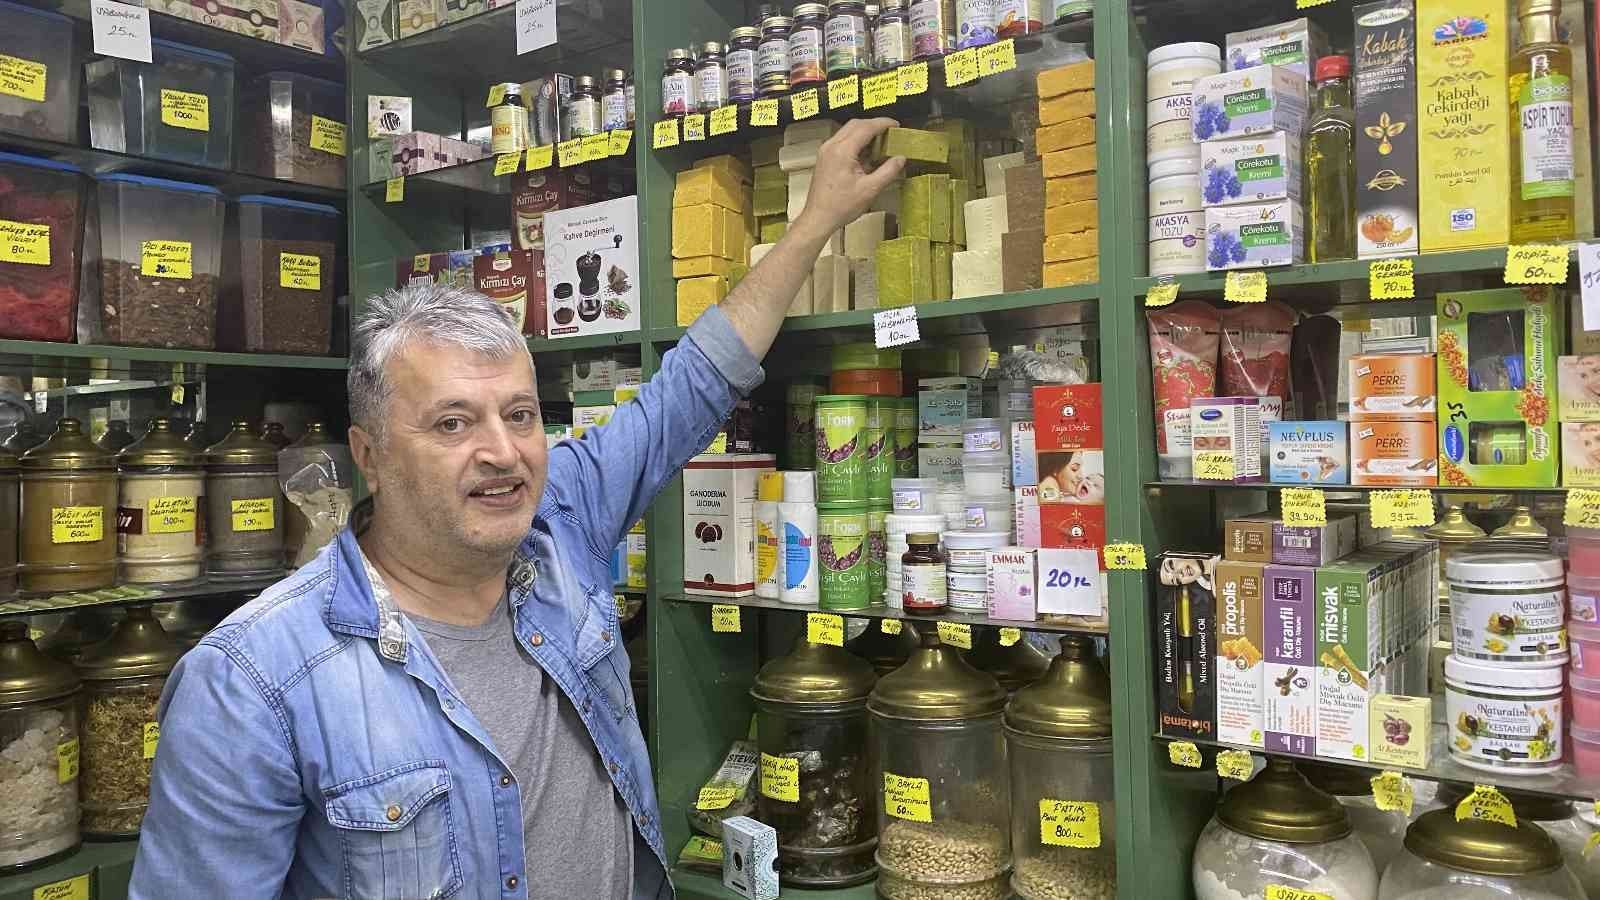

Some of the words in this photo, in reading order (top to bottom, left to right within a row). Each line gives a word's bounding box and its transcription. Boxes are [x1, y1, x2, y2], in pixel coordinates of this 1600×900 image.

[1437, 85, 1479, 102] Kabak
[1166, 97, 1193, 109] AKAS
[1426, 96, 1490, 117] Çekirdeği
[1175, 108, 1191, 117] TOZ
[1443, 112, 1473, 127] yağı
[1550, 104, 1573, 127] TOHU
[1155, 215, 1190, 228] AKASYA
[1452, 212, 1473, 222] ISO
[480, 278, 511, 290] Kırmızı
[512, 275, 527, 288] Çay
[1447, 401, 1468, 423] 35
[1280, 431, 1335, 442] NEVPLUS
[690, 490, 727, 498] GANODERMA
[992, 554, 1025, 566] EMMAK
[1045, 568, 1073, 588] 20
[1222, 582, 1240, 636] propolis
[1322, 586, 1339, 643] misvak
[1279, 607, 1294, 659] karanfil
[1163, 714, 1212, 733] biotama
